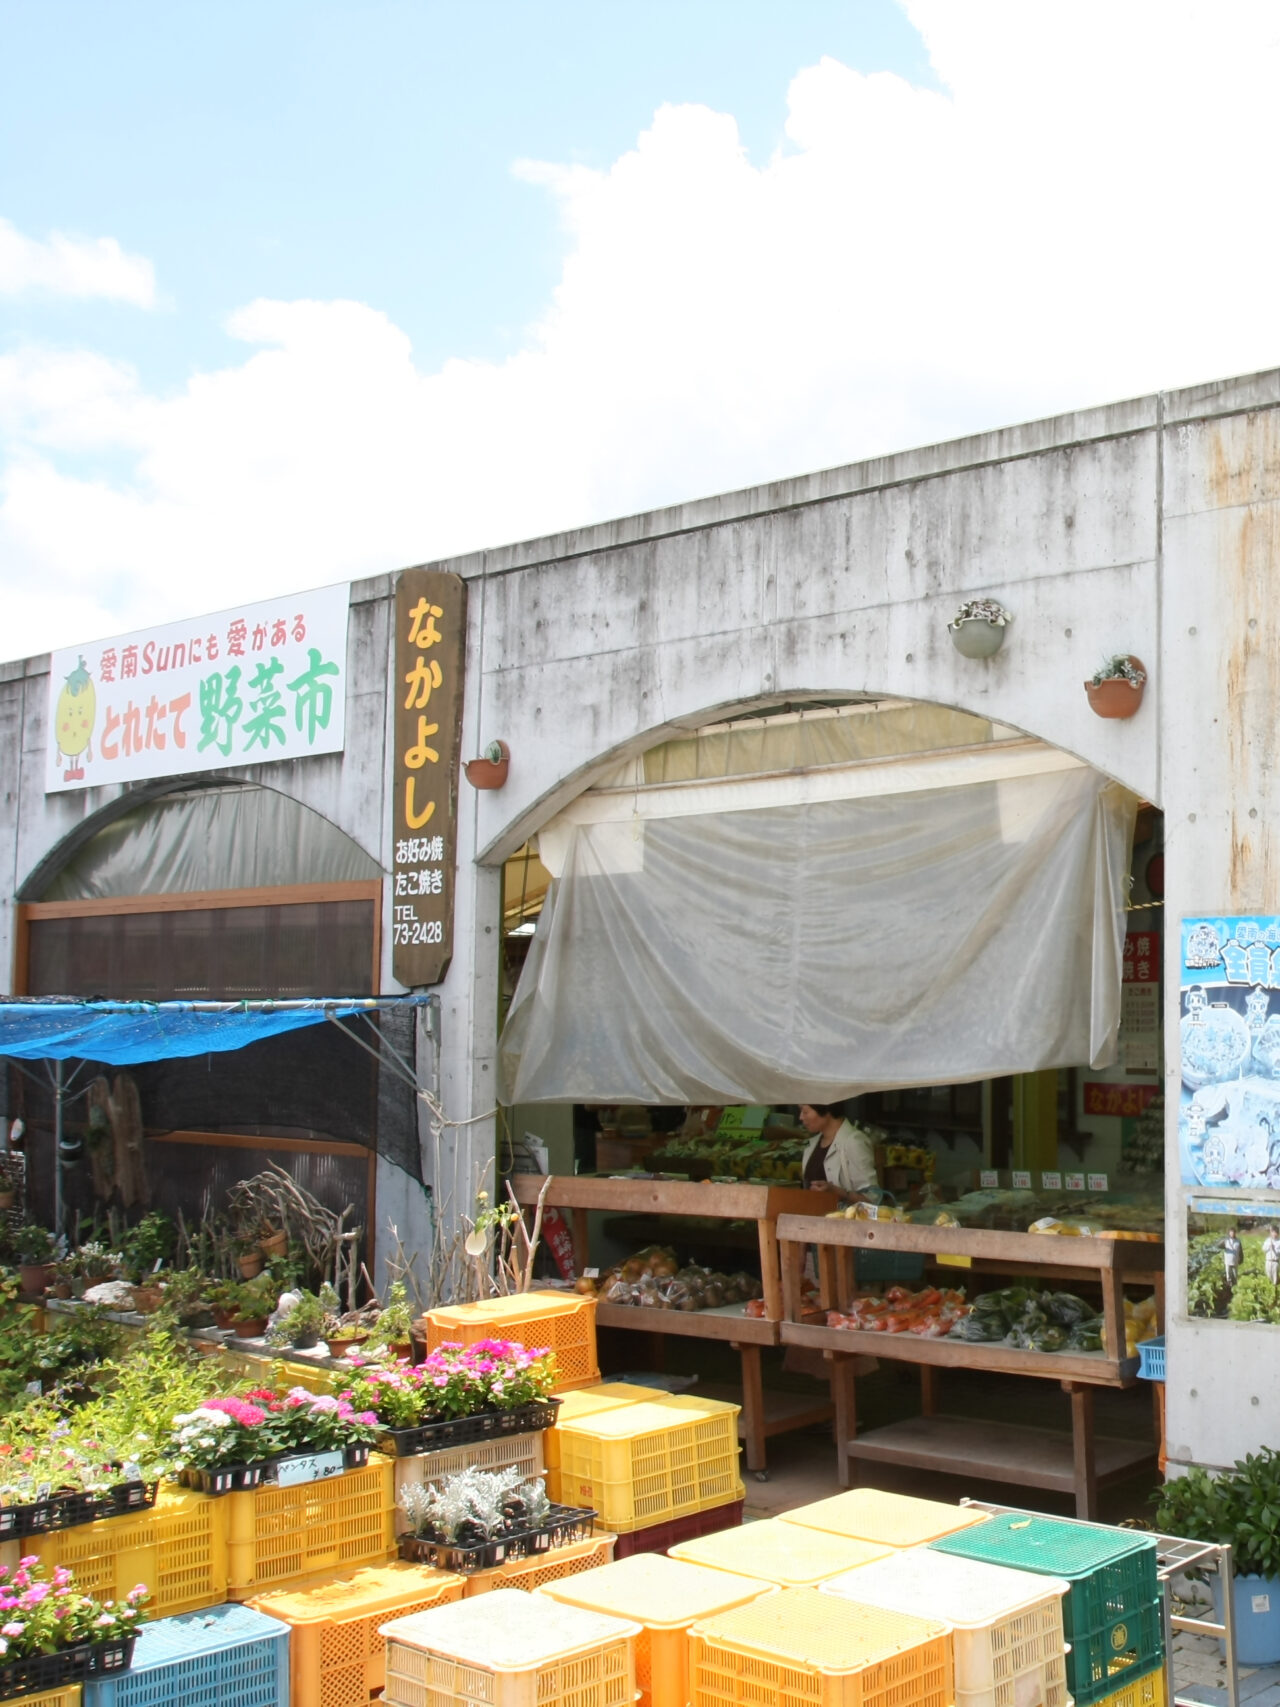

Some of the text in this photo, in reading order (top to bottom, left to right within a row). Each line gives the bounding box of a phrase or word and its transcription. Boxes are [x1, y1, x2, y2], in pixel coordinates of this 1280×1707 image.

[226, 614, 306, 656] 愛がある
[100, 648, 340, 760] とれたて 野菜市
[404, 597, 444, 829] なかよし
[396, 836, 443, 863] お好み焼
[396, 869, 442, 896] たこ焼き
[394, 905, 418, 920] TEL
[394, 921, 442, 945] 73-2428
